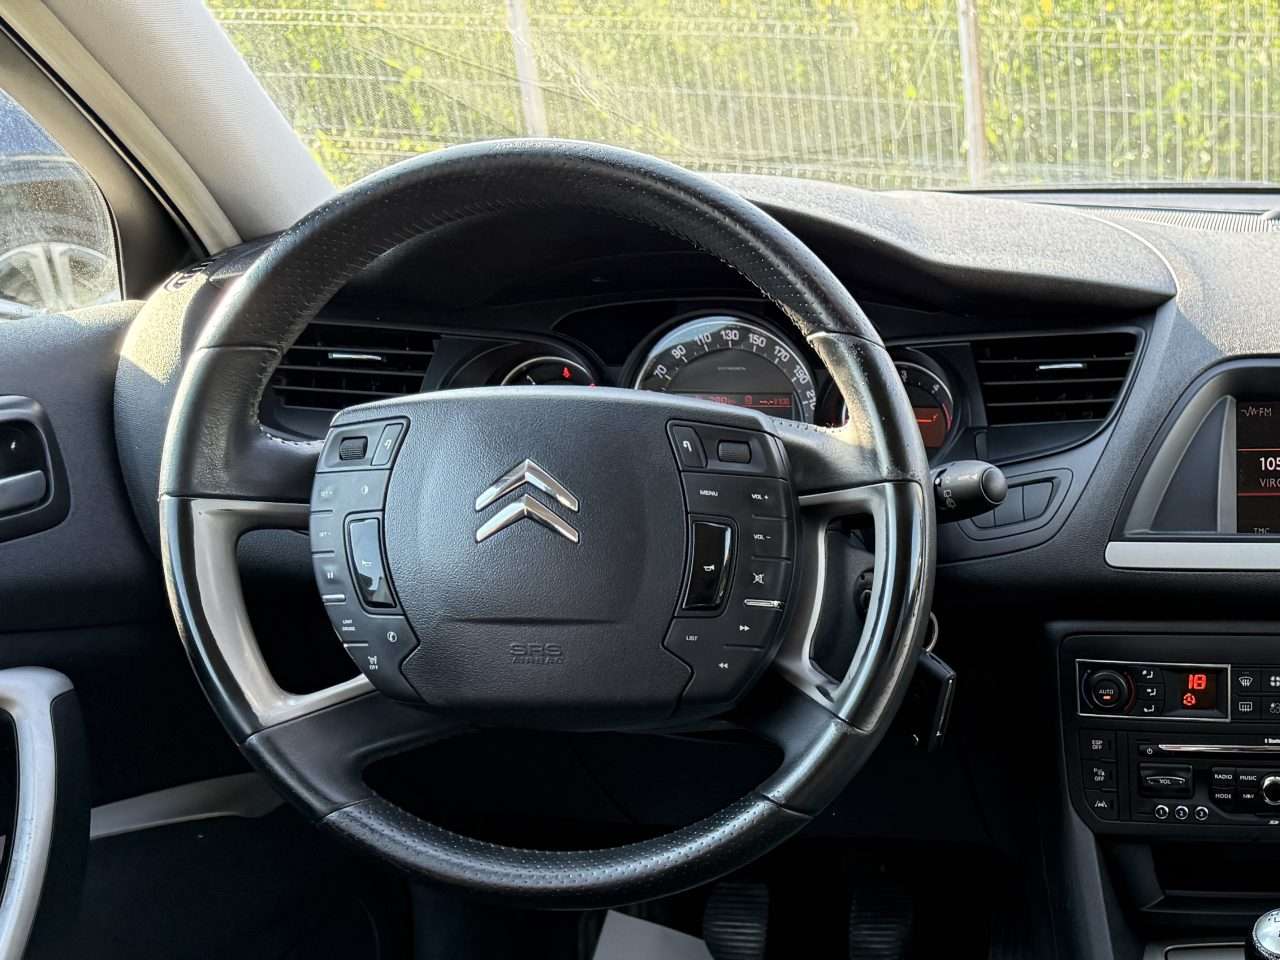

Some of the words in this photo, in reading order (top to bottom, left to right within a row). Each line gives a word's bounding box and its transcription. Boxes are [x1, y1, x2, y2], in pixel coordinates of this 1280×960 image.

[694, 331, 712, 345] 110
[720, 329, 739, 341] 130
[748, 333, 767, 348] 150
[671, 344, 686, 360] 90
[773, 345, 790, 362] 170
[653, 364, 667, 379] 70
[793, 364, 809, 384] 190
[700, 489, 718, 497] MENU
[1188, 674, 1207, 689] 18
